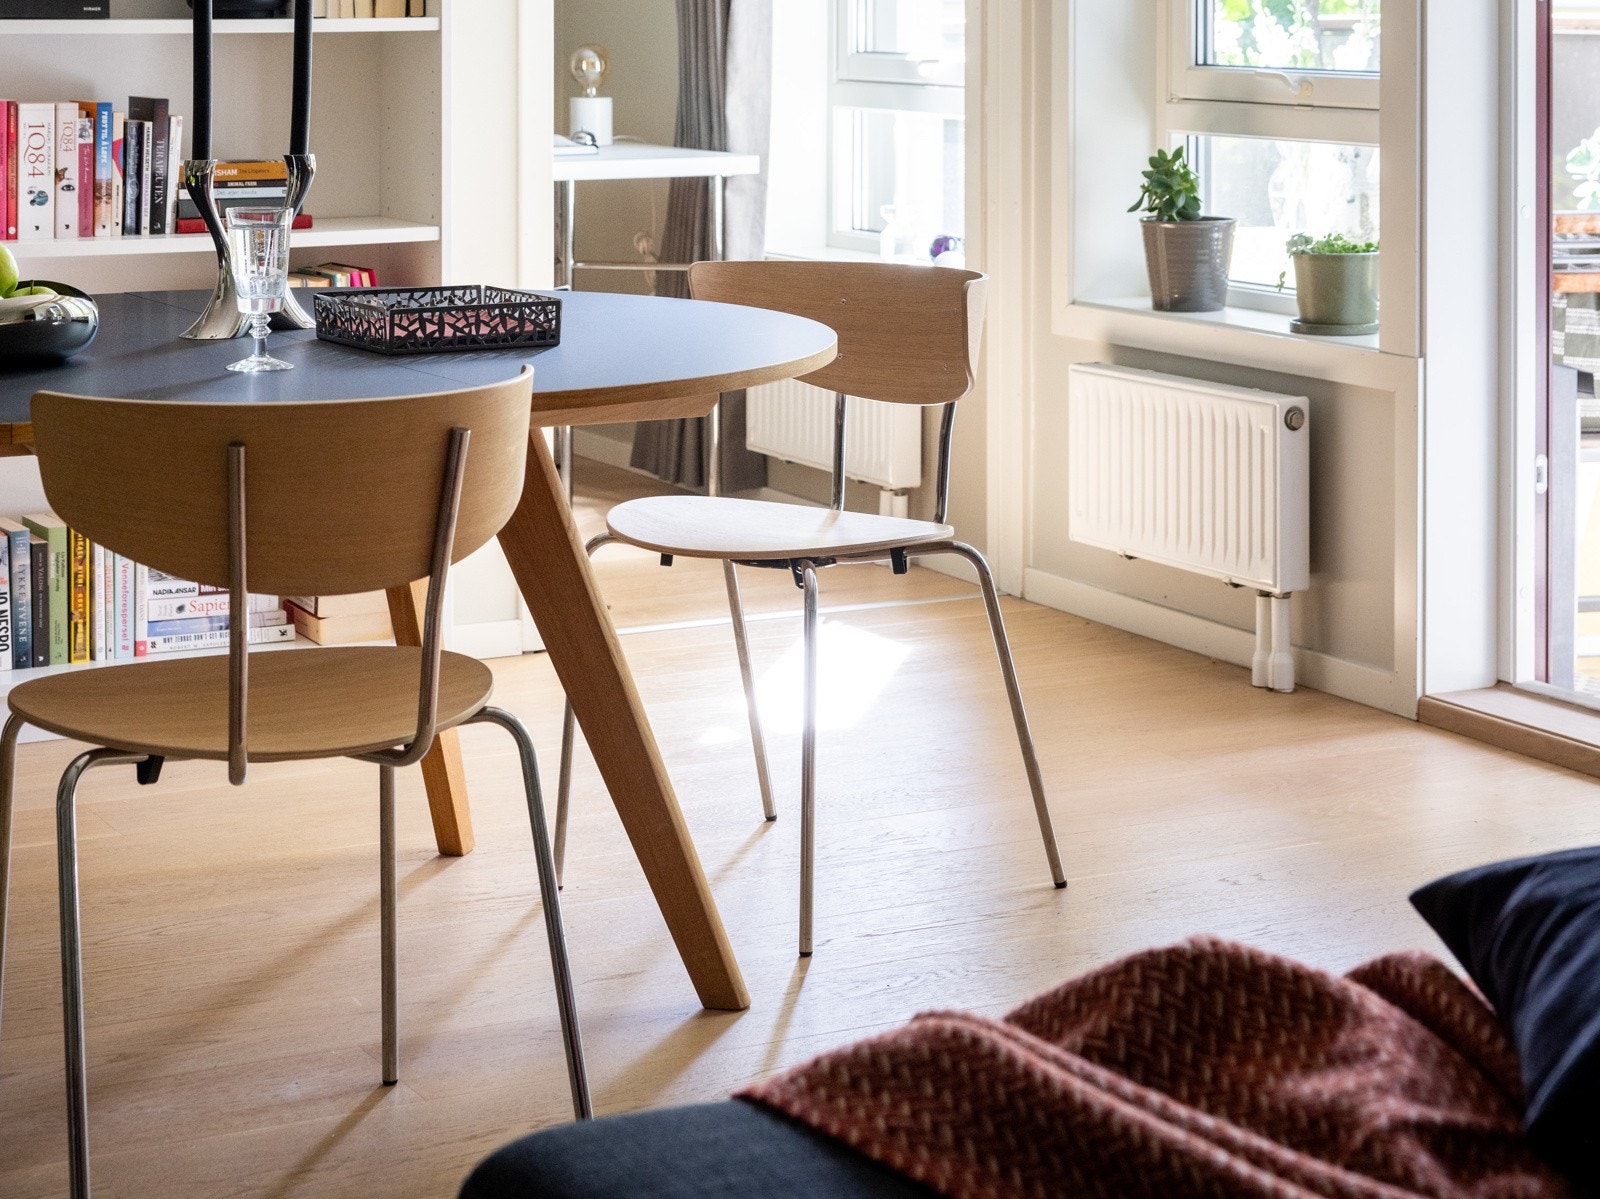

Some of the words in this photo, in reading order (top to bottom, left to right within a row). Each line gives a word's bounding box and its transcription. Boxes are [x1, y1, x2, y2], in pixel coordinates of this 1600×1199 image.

[24, 122, 46, 178] 1Q84
[61, 121, 74, 152] 1Q84
[154, 138, 165, 204] TERAPEUTEN
[18, 564, 27, 643] LYKKETYVENE
[120, 563, 129, 641] Venneforespørsel
[153, 588, 173, 596] NADIA
[174, 586, 196, 594] ANSAR
[189, 600, 230, 616] Sapie
